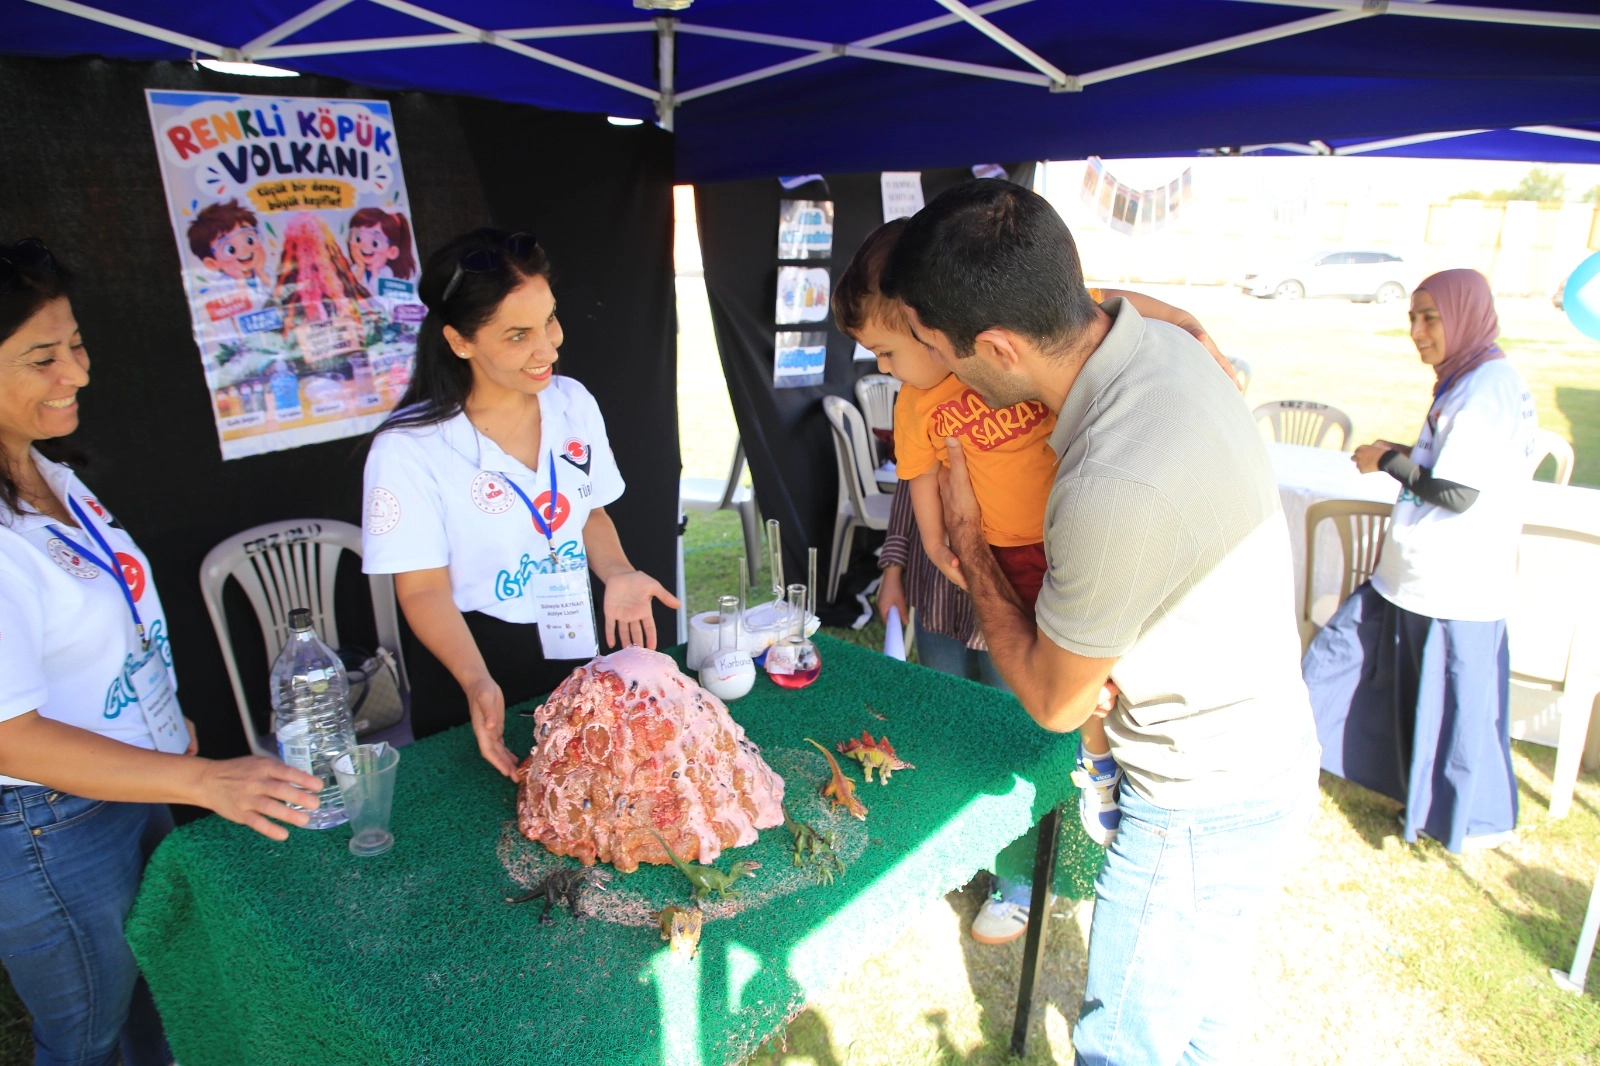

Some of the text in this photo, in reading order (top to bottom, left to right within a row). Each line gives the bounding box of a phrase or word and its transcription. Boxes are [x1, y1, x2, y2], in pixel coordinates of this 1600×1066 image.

[297, 107, 392, 157] KÖPÜK
[217, 142, 369, 184] VOLKANI
[291, 181, 306, 192] bir
[971, 400, 1044, 446] SARAY
